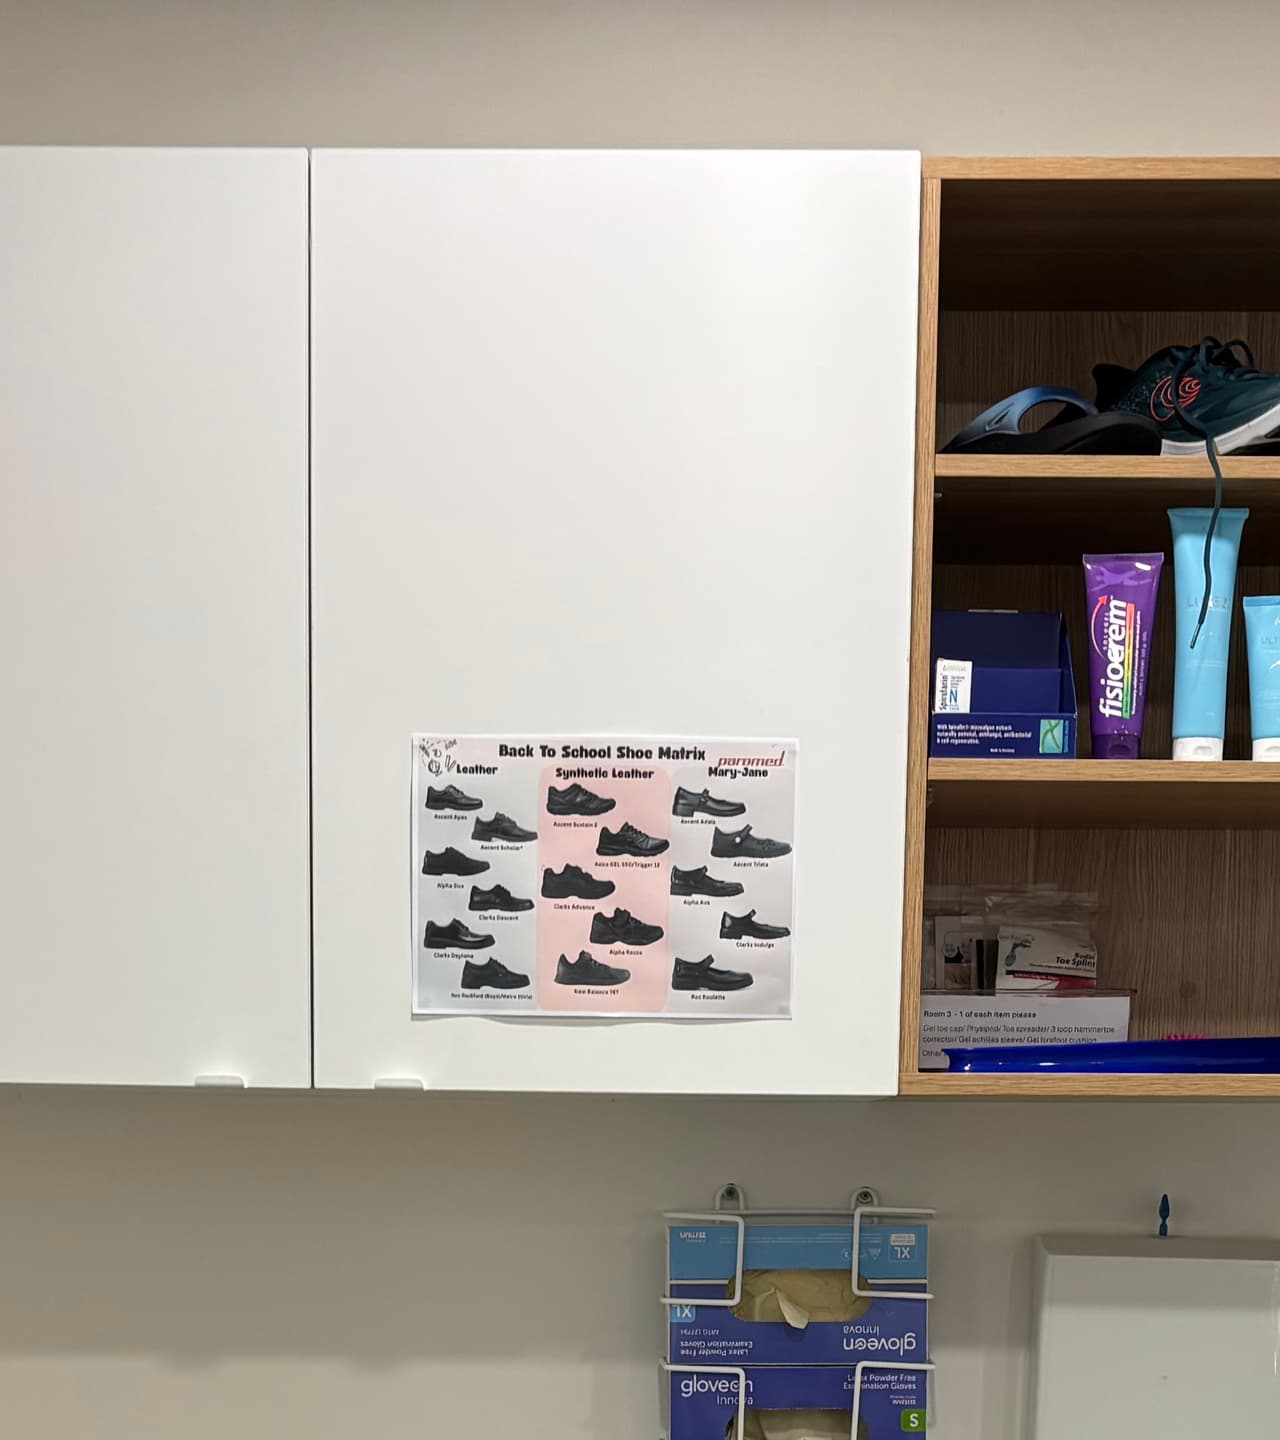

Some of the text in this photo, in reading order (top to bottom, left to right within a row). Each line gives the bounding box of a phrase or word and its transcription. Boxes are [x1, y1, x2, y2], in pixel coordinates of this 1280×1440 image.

[1098, 599, 1127, 718] fisiocrem
[949, 688, 958, 705] N
[499, 744, 706, 761] Back To School Shoe Matrix
[456, 764, 498, 775] Leather
[555, 767, 655, 780] Synthetic Leather
[708, 767, 768, 779] Mary-Jane
[1055, 956, 1096, 968] Toe Splint
[964, 1010, 973, 1018] of
[1011, 1011, 1037, 1019] please
[895, 1247, 910, 1259] XL
[843, 1325, 879, 1336] Innova
[708, 1340, 753, 1348] Examination
[843, 1332, 916, 1356] gloveon
[680, 1348, 748, 1356] Latex Powder Free
[890, 1382, 916, 1390] Gloves
[910, 1413, 919, 1427] S
